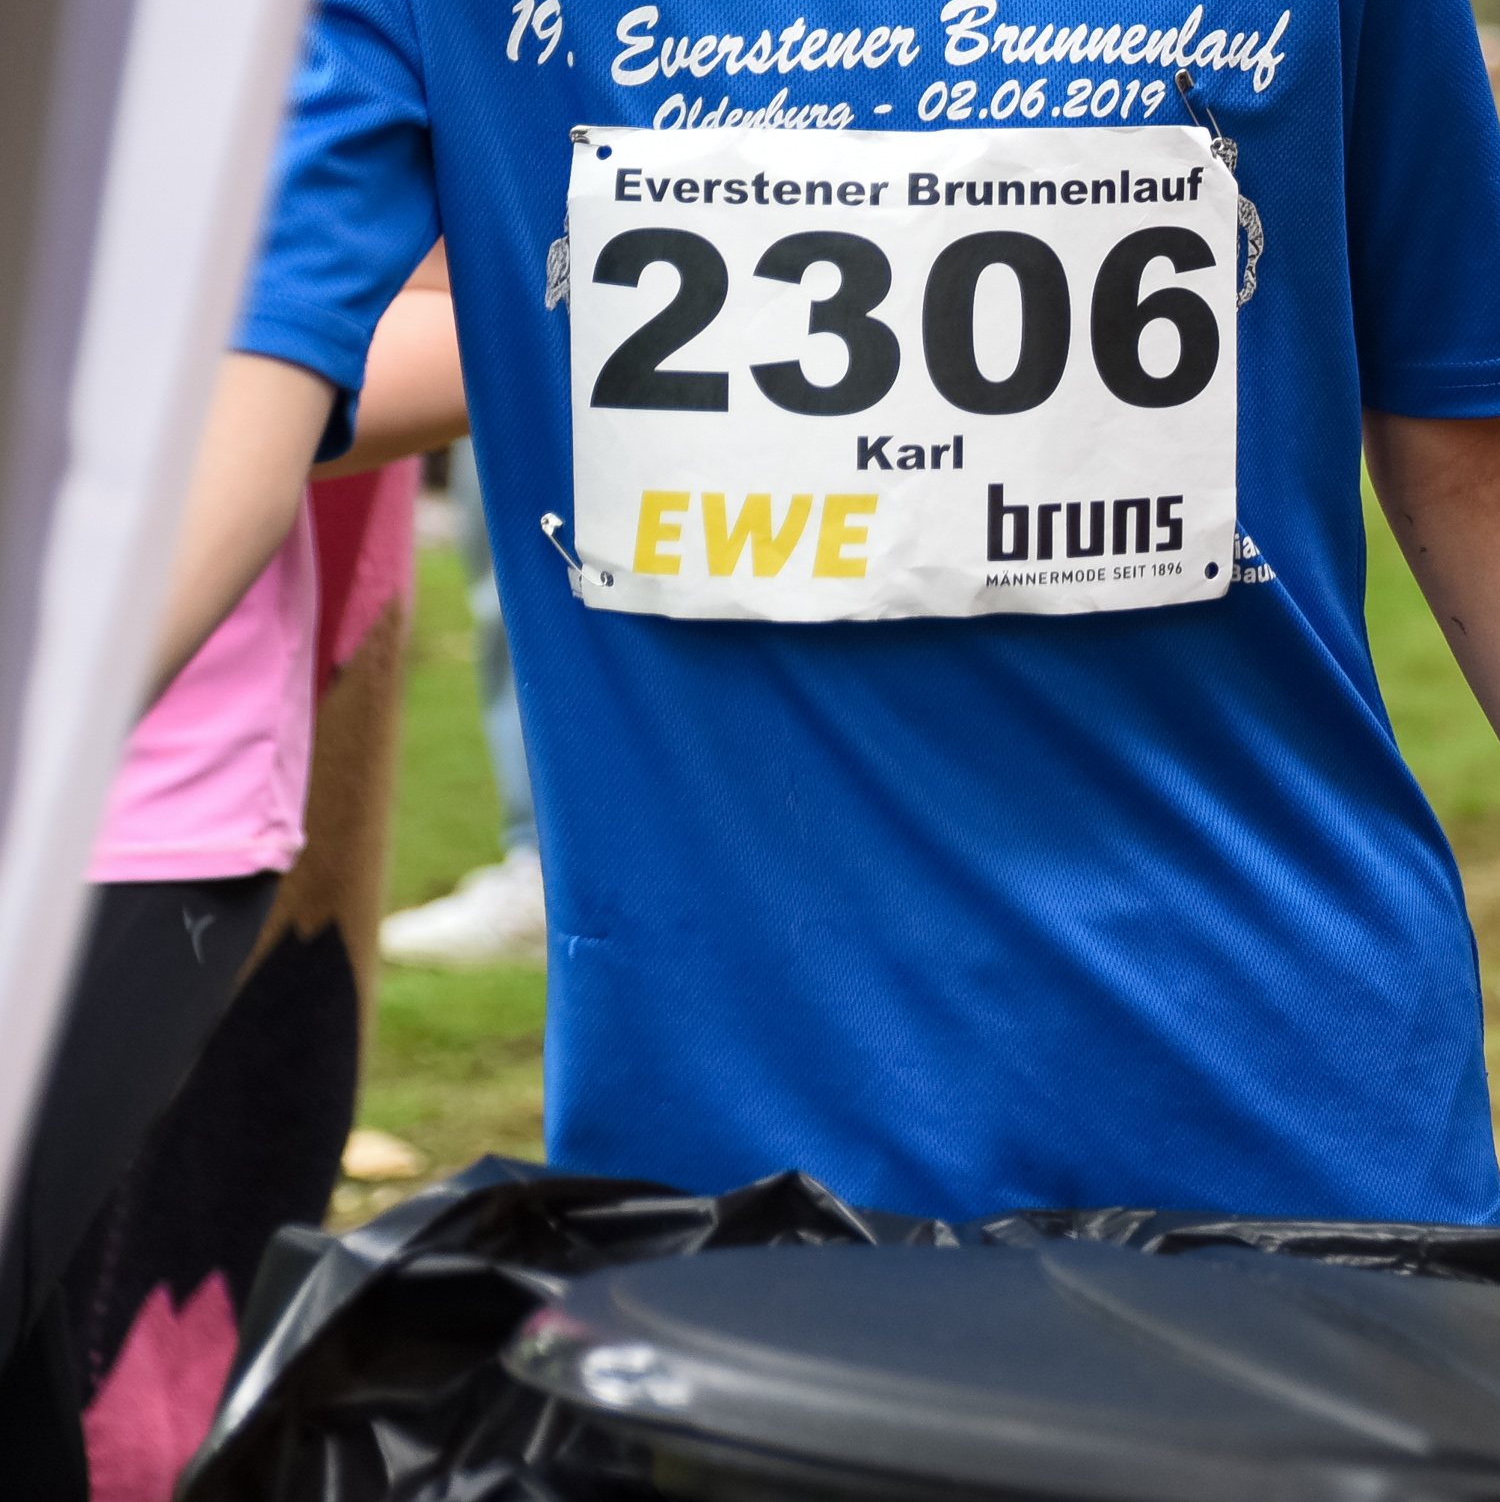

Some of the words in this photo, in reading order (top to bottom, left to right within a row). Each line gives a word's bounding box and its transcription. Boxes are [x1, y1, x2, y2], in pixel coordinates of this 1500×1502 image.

[611, 5, 921, 86] Everstener
[653, 87, 855, 130] Oldenburg
[918, 78, 1166, 121] 02.06.2019
[615, 168, 889, 206] Everstener
[908, 166, 1204, 206] Brunnenlauf
[590, 226, 1220, 417] 2306
[857, 435, 964, 471] Karl
[632, 489, 879, 579] EWE
[987, 483, 1184, 561] bruns
[986, 568, 1106, 588] MÄNNERMODE
[1113, 564, 1147, 580] SEIT
[1152, 561, 1183, 577] 1896
